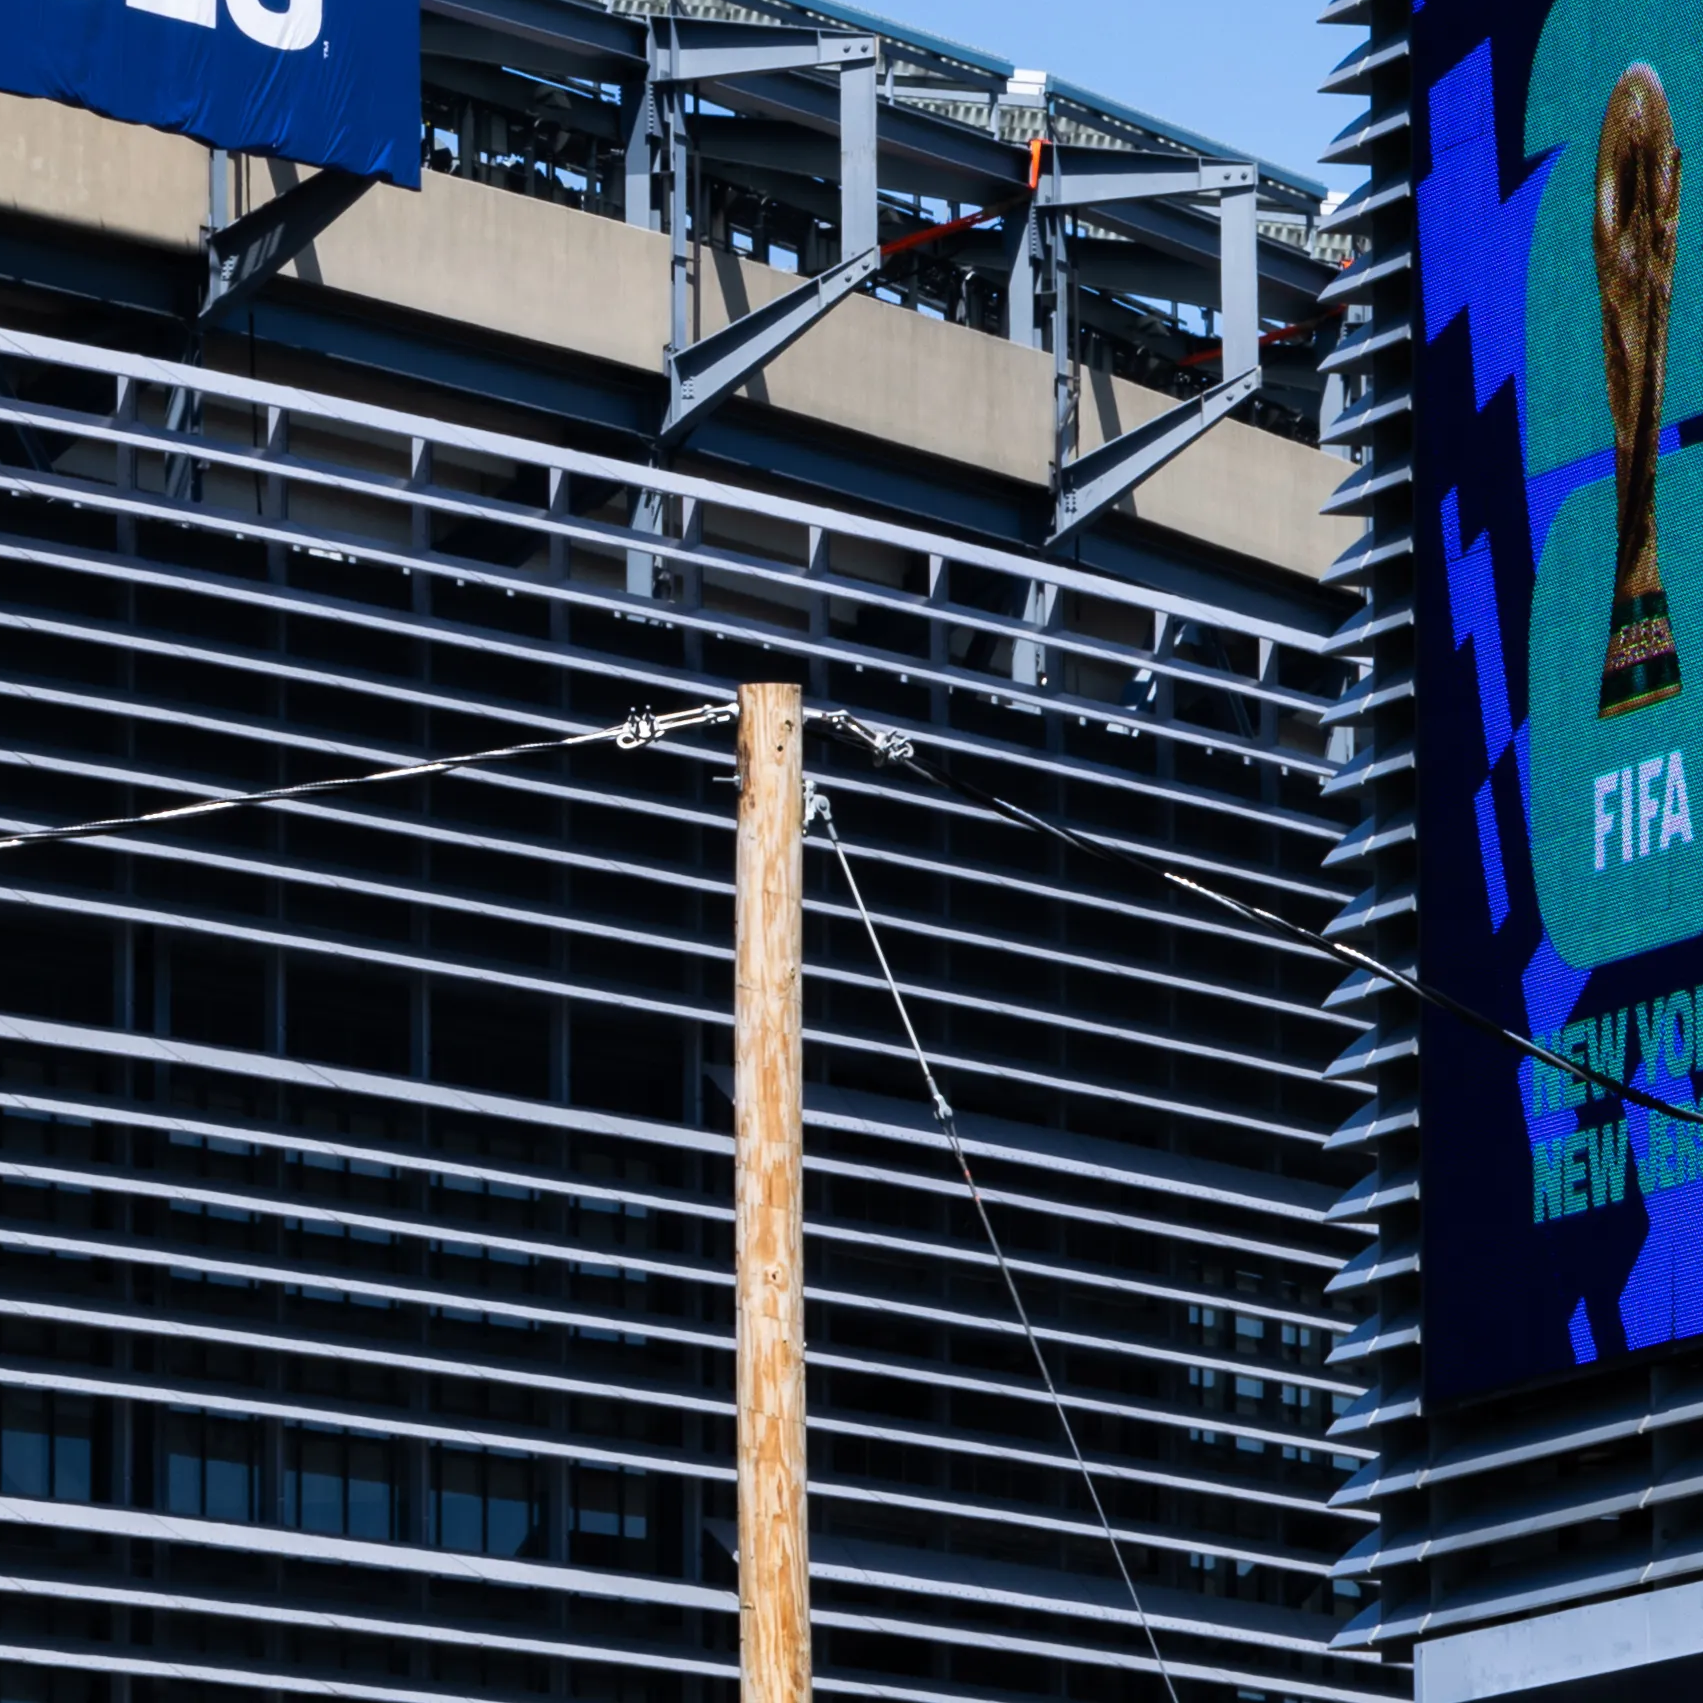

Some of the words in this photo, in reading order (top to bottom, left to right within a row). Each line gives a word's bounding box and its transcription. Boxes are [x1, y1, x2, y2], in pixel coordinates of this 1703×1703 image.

[1594, 750, 1694, 871] FIFA
[1532, 1006, 1629, 1118] NEW
[1533, 1118, 1628, 1224] NEW
